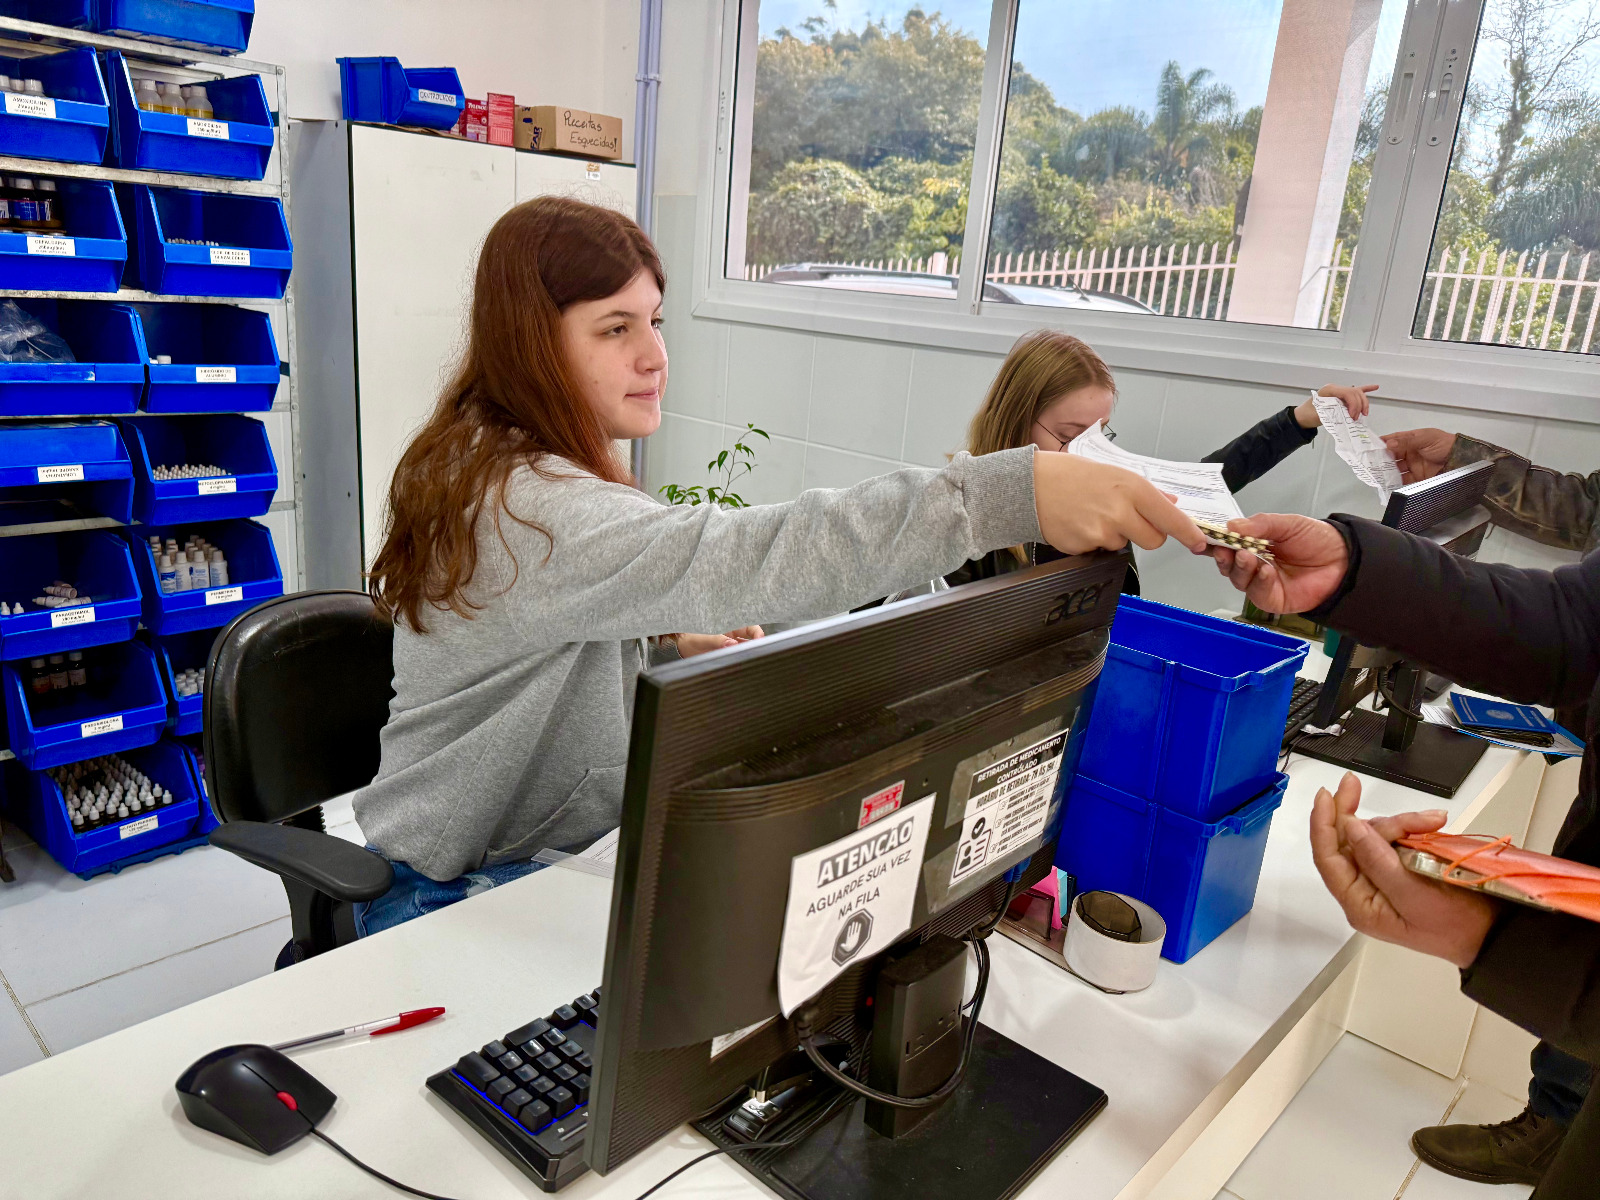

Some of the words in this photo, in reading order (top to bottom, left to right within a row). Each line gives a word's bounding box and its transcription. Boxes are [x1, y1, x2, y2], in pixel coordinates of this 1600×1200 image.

[564, 110, 602, 132] Receitas
[570, 131, 617, 152] Esquecidas!
[1044, 579, 1113, 626] acer
[977, 763, 1008, 783] RETIRADA
[1010, 757, 1019, 766] DE
[1019, 737, 1061, 762] MEDICAMENTO
[818, 820, 913, 886] ATENÇÃO
[806, 875, 864, 916] AGUARDE
[866, 862, 887, 882] SUA
[891, 850, 911, 868] VEZ
[838, 902, 852, 920] NA
[855, 887, 880, 908] FILA
